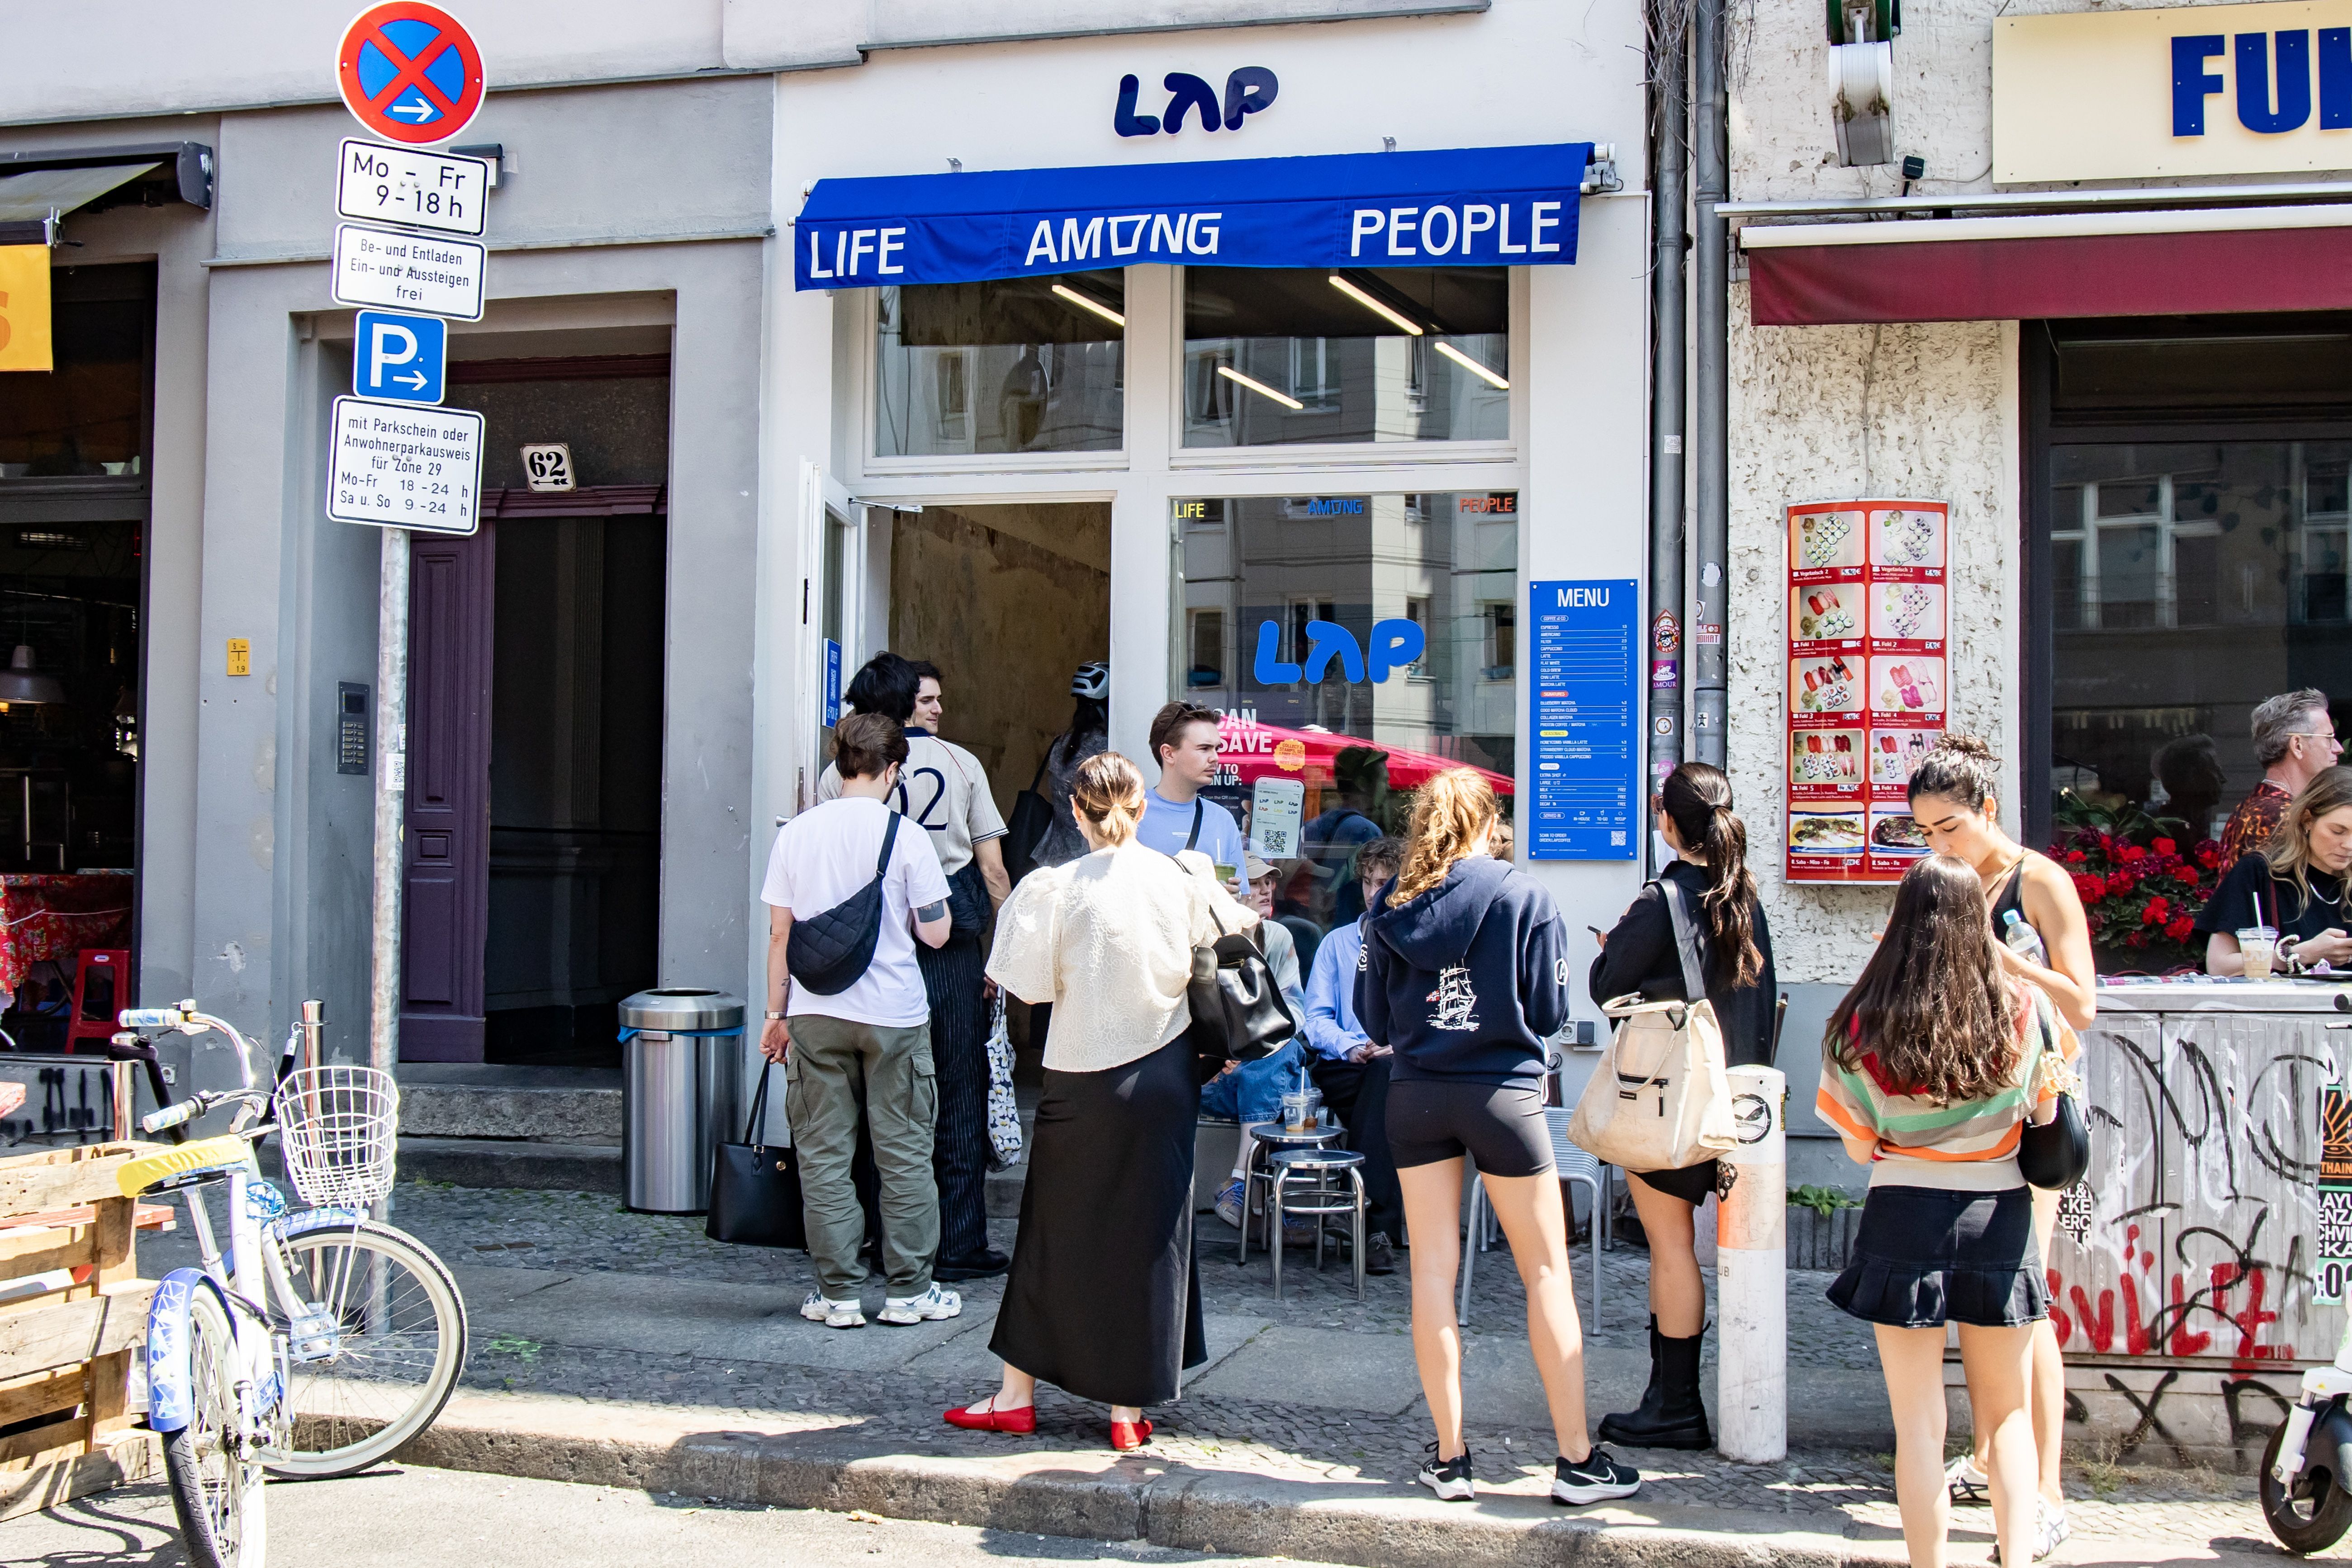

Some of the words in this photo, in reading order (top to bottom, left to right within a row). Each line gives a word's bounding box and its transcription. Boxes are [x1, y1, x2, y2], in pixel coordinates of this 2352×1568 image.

[1114, 66, 1280, 138] LAP
[354, 152, 389, 178] Mo
[440, 166, 465, 190] Fr
[449, 195, 462, 218] h
[1025, 212, 1223, 265] AMONG
[1351, 201, 1561, 257] PEOPLE
[361, 238, 381, 253] Be-
[386, 244, 406, 258] und
[413, 246, 462, 265] Entladen
[810, 227, 906, 279] LIFE
[351, 258, 375, 273] Ein-
[379, 264, 400, 277] und
[407, 267, 469, 288] Aussteigen
[396, 285, 422, 301] frei
[370, 322, 417, 388] P
[348, 417, 367, 431] mit
[375, 418, 436, 438] Parkschein
[443, 430, 469, 442] oder
[344, 434, 470, 461] Anwohnerparkausweis
[372, 456, 389, 470] für
[395, 459, 422, 474] Zone
[428, 462, 441, 476] 29
[529, 451, 566, 478] 62
[341, 472, 378, 488] Mo-Fr
[400, 479, 414, 492] 18
[461, 485, 468, 498] h
[340, 491, 354, 504] Sa
[360, 497, 370, 506] u.
[377, 495, 391, 508] So
[405, 498, 414, 510] 9
[460, 503, 467, 517] h
[1176, 503, 1204, 518] LIFE
[1308, 499, 1363, 515] AMONG
[1460, 497, 1513, 512] PEOPLE
[1557, 588, 1609, 607] MENU
[1254, 618, 1425, 684] LAP
[1224, 764, 1238, 775] TO
[1224, 775, 1242, 786] UP:
